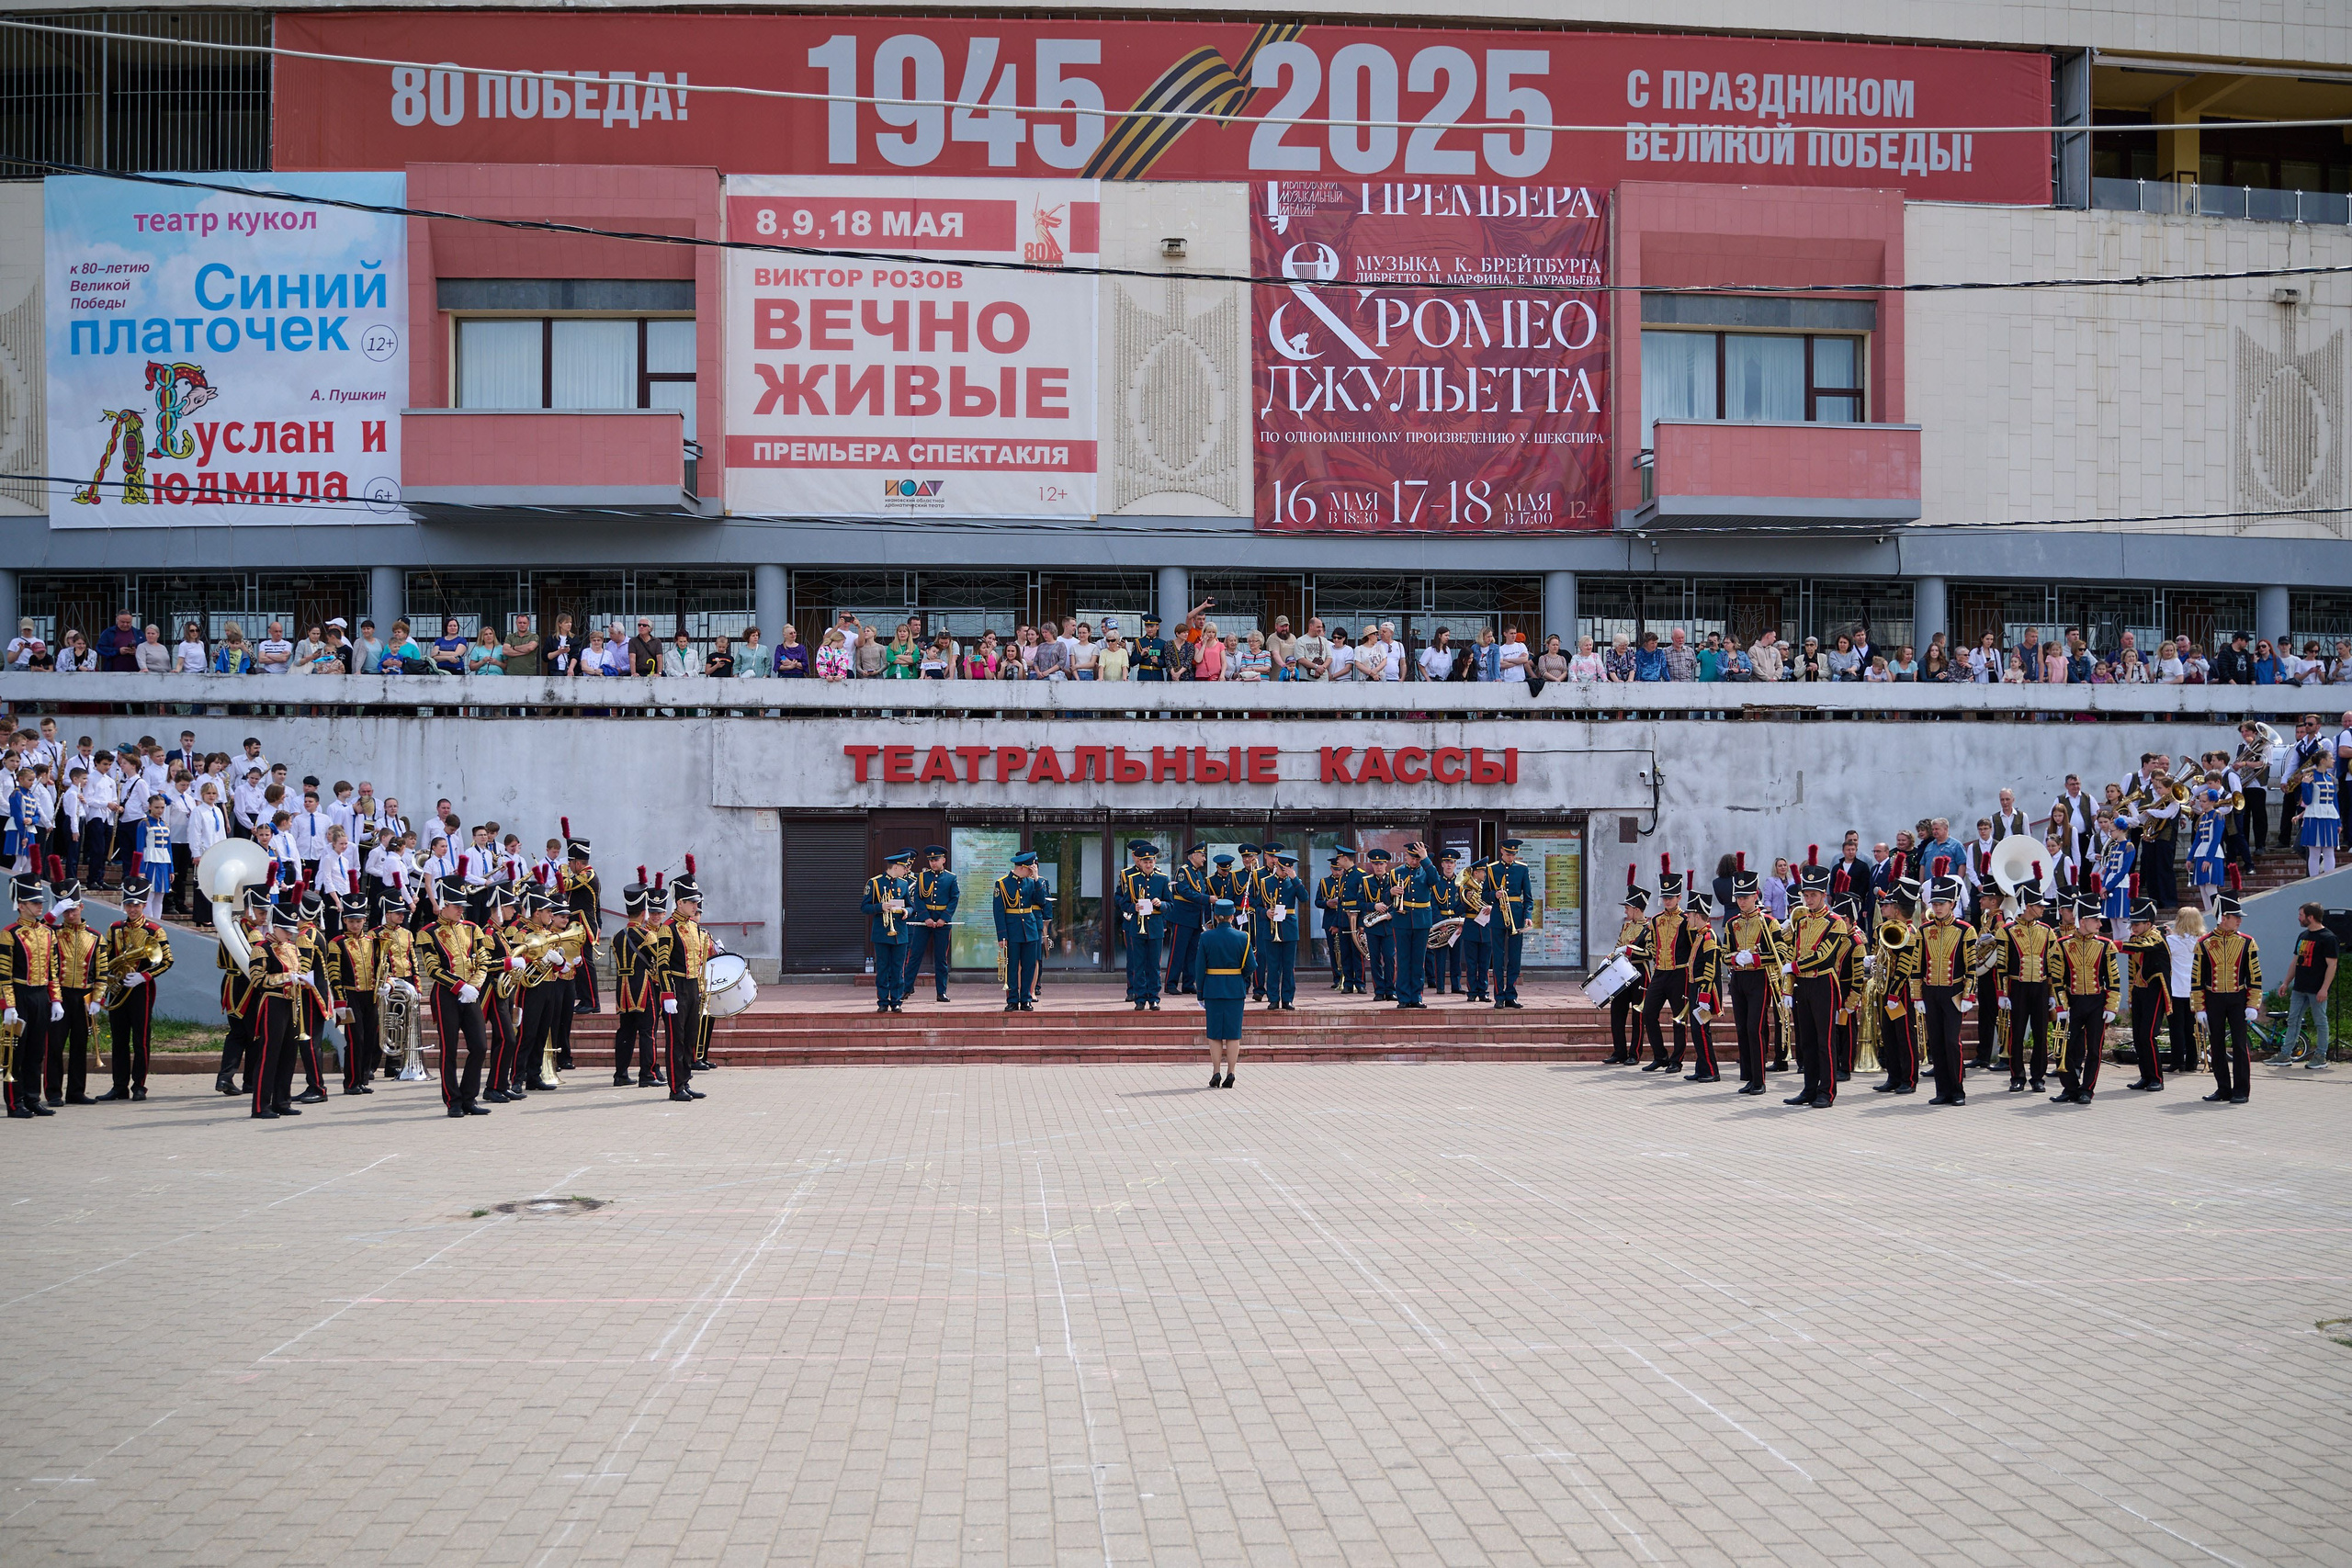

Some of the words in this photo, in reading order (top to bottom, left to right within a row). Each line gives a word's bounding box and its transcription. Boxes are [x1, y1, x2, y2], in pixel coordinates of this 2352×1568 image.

[391, 62, 465, 127] 80
[478, 70, 688, 129] ПОБЕДА!
[808, 34, 1102, 169] 1945
[1249, 41, 1554, 177] 2025
[1626, 70, 1650, 108] С
[1662, 70, 1915, 119] ПРАЗДНИКОМ
[1626, 122, 1795, 166] ВЕЛИКОЙ
[1807, 129, 1973, 177] ПОБЕДЫ!
[1278, 190, 1343, 203] МУЗЫКАЛЬНЫЙ
[1356, 183, 1600, 219] ПРЕМЬЕРА
[133, 211, 219, 238] театр
[228, 210, 318, 237] кукол
[882, 210, 965, 238] МАЯ
[1024, 243, 1046, 261] 80
[70, 265, 78, 275] к
[1355, 256, 1442, 273] МУЗЫКА
[1454, 257, 1473, 273] К.
[1481, 254, 1601, 274] БРЕЙТБУРГА
[70, 278, 131, 293] Великой
[194, 260, 387, 312] Синий
[754, 268, 864, 288] ВИКТОР
[872, 269, 964, 289] РОЗОВ
[1355, 273, 1421, 283] ЛИБРЕТТО
[1428, 274, 1442, 284] М.
[1447, 275, 1513, 286] МАРФИНА,
[1518, 275, 1529, 285] Е.
[1532, 275, 1601, 286] МУРАВЬЕВА
[70, 298, 127, 310] Победы
[71, 315, 350, 355] платочек
[753, 298, 1031, 355] ВЕЧНО
[1374, 299, 1598, 350] РОМЕО
[368, 336, 395, 352] 12+
[310, 389, 325, 401] А.
[329, 389, 387, 403] Пушкин
[752, 363, 1069, 419] ЖИВЫЕ
[1261, 366, 1601, 421] ДЖУЛЬЕТТА
[362, 420, 388, 453] и
[1260, 431, 1280, 443] ПО
[1284, 431, 1401, 444] ОДНОИМЕННОМУ
[1406, 432, 1515, 445] ПРОИЗВЕДЕНИЮ
[1520, 433, 1531, 444] У.
[1534, 433, 1604, 445] ШЕКСПИРА
[753, 442, 900, 463] ПРЕМЬЕРА
[908, 444, 1069, 466] СПЕКТАКЛЯ
[374, 488, 394, 503] 6+
[1037, 486, 1069, 502] 12+
[1272, 479, 1317, 525] 16
[1330, 491, 1379, 511] МАЯ
[1503, 492, 1552, 512] МАЯ
[1329, 512, 1338, 525] В
[1343, 512, 1379, 525] 18:30
[1505, 513, 1514, 525] В
[1520, 512, 1553, 525] 17:00
[1569, 500, 1598, 520] 12+
[843, 745, 1279, 784] ТЕАТРАЛЬНЫЕ
[1320, 745, 1519, 784] КАССЫ
